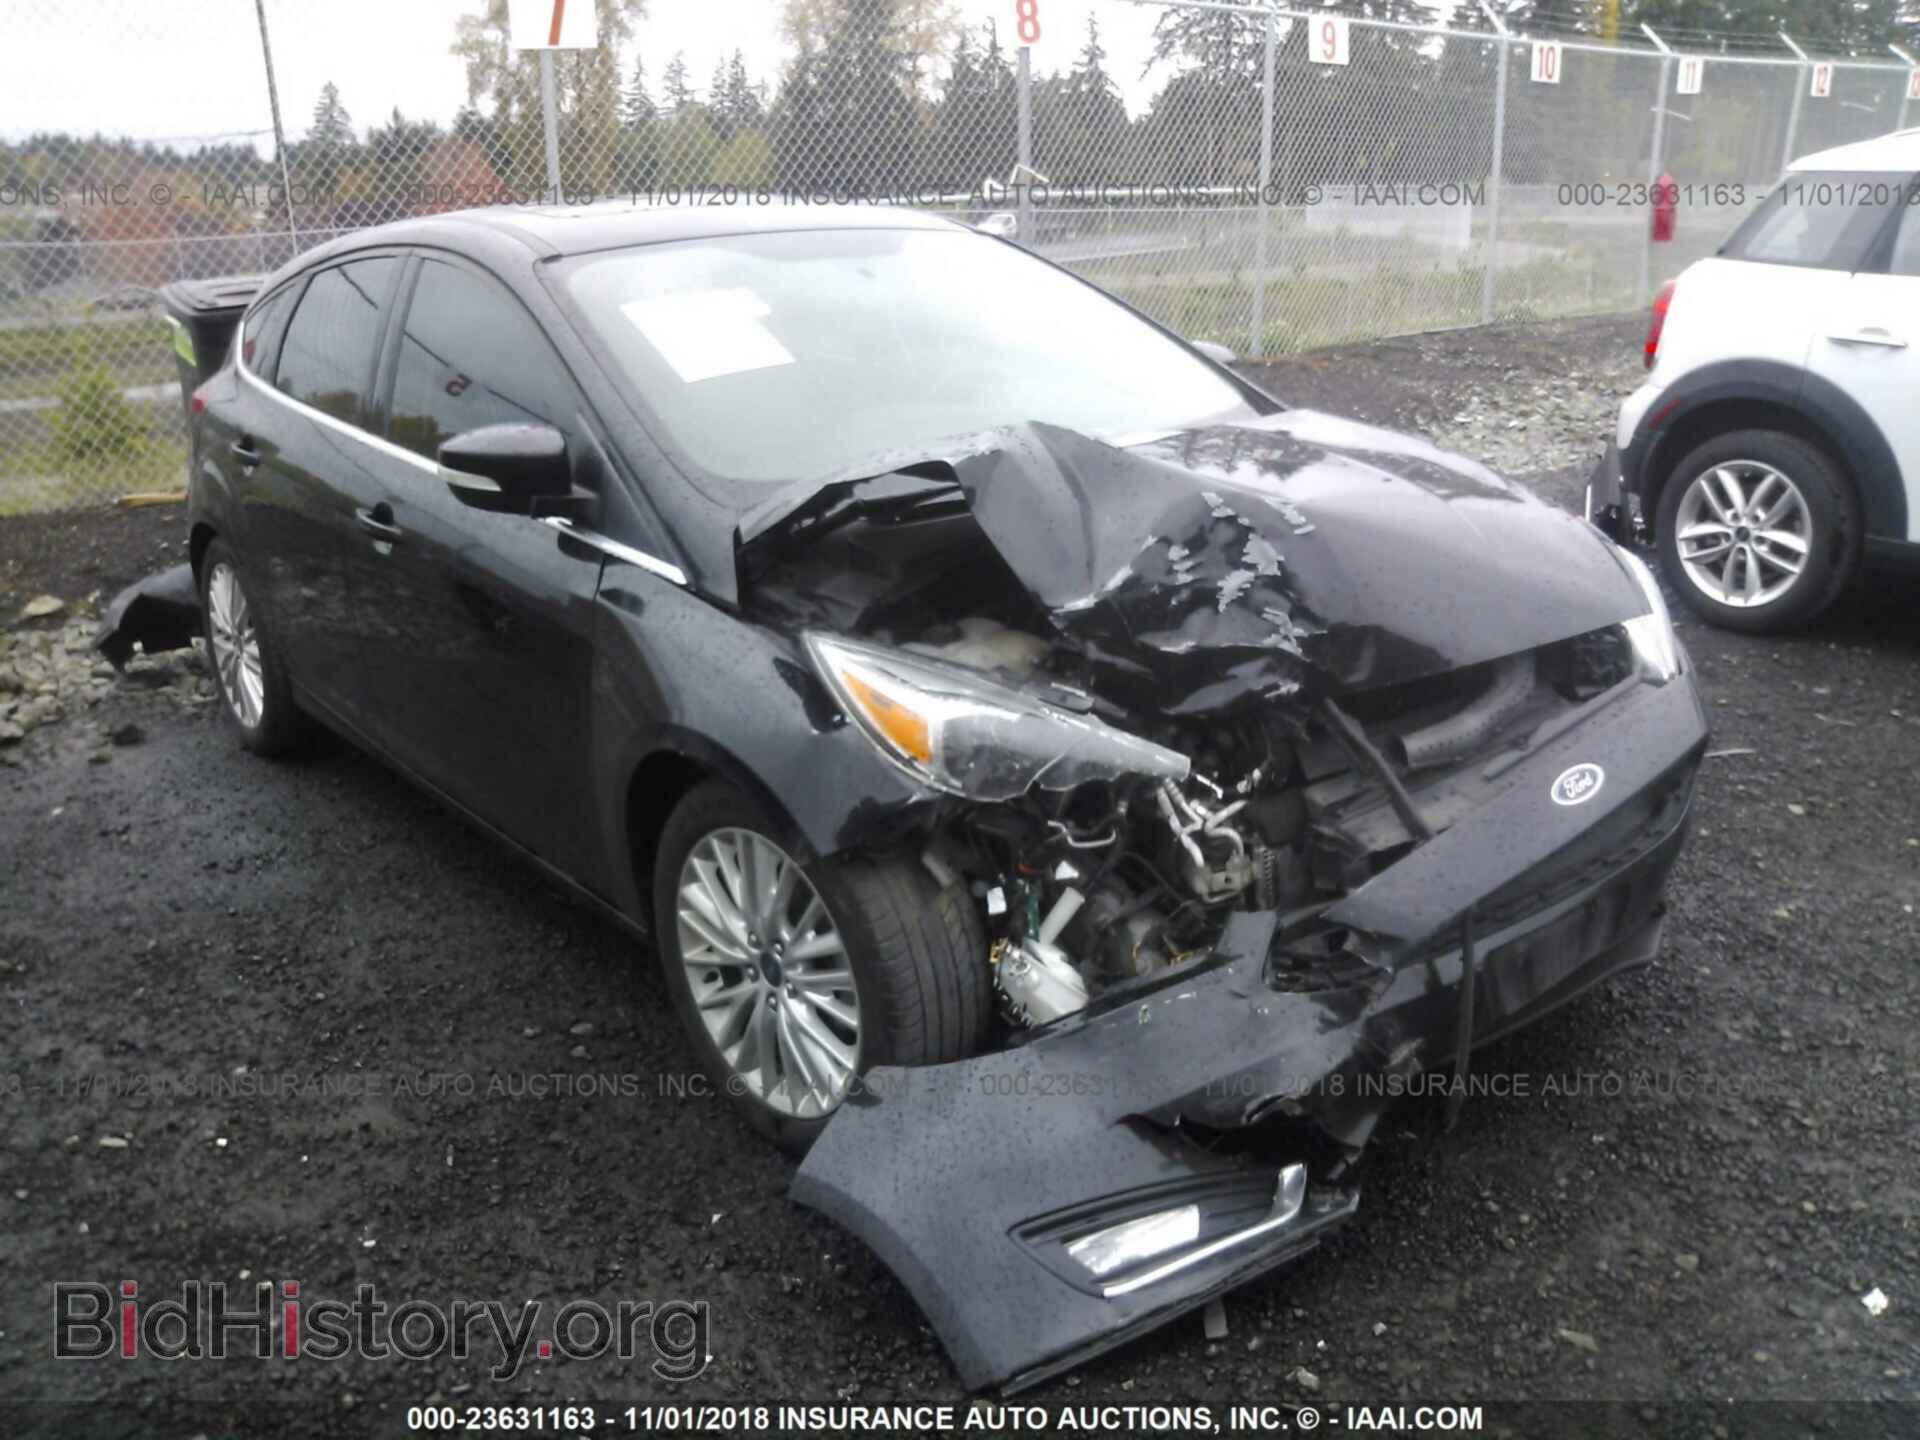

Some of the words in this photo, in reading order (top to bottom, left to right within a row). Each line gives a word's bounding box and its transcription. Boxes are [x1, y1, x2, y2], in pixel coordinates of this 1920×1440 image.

[1015, 0, 1041, 43] 8
[1322, 20, 1336, 60] 9
[1538, 46, 1556, 80] 10
[1685, 61, 1698, 89] 11
